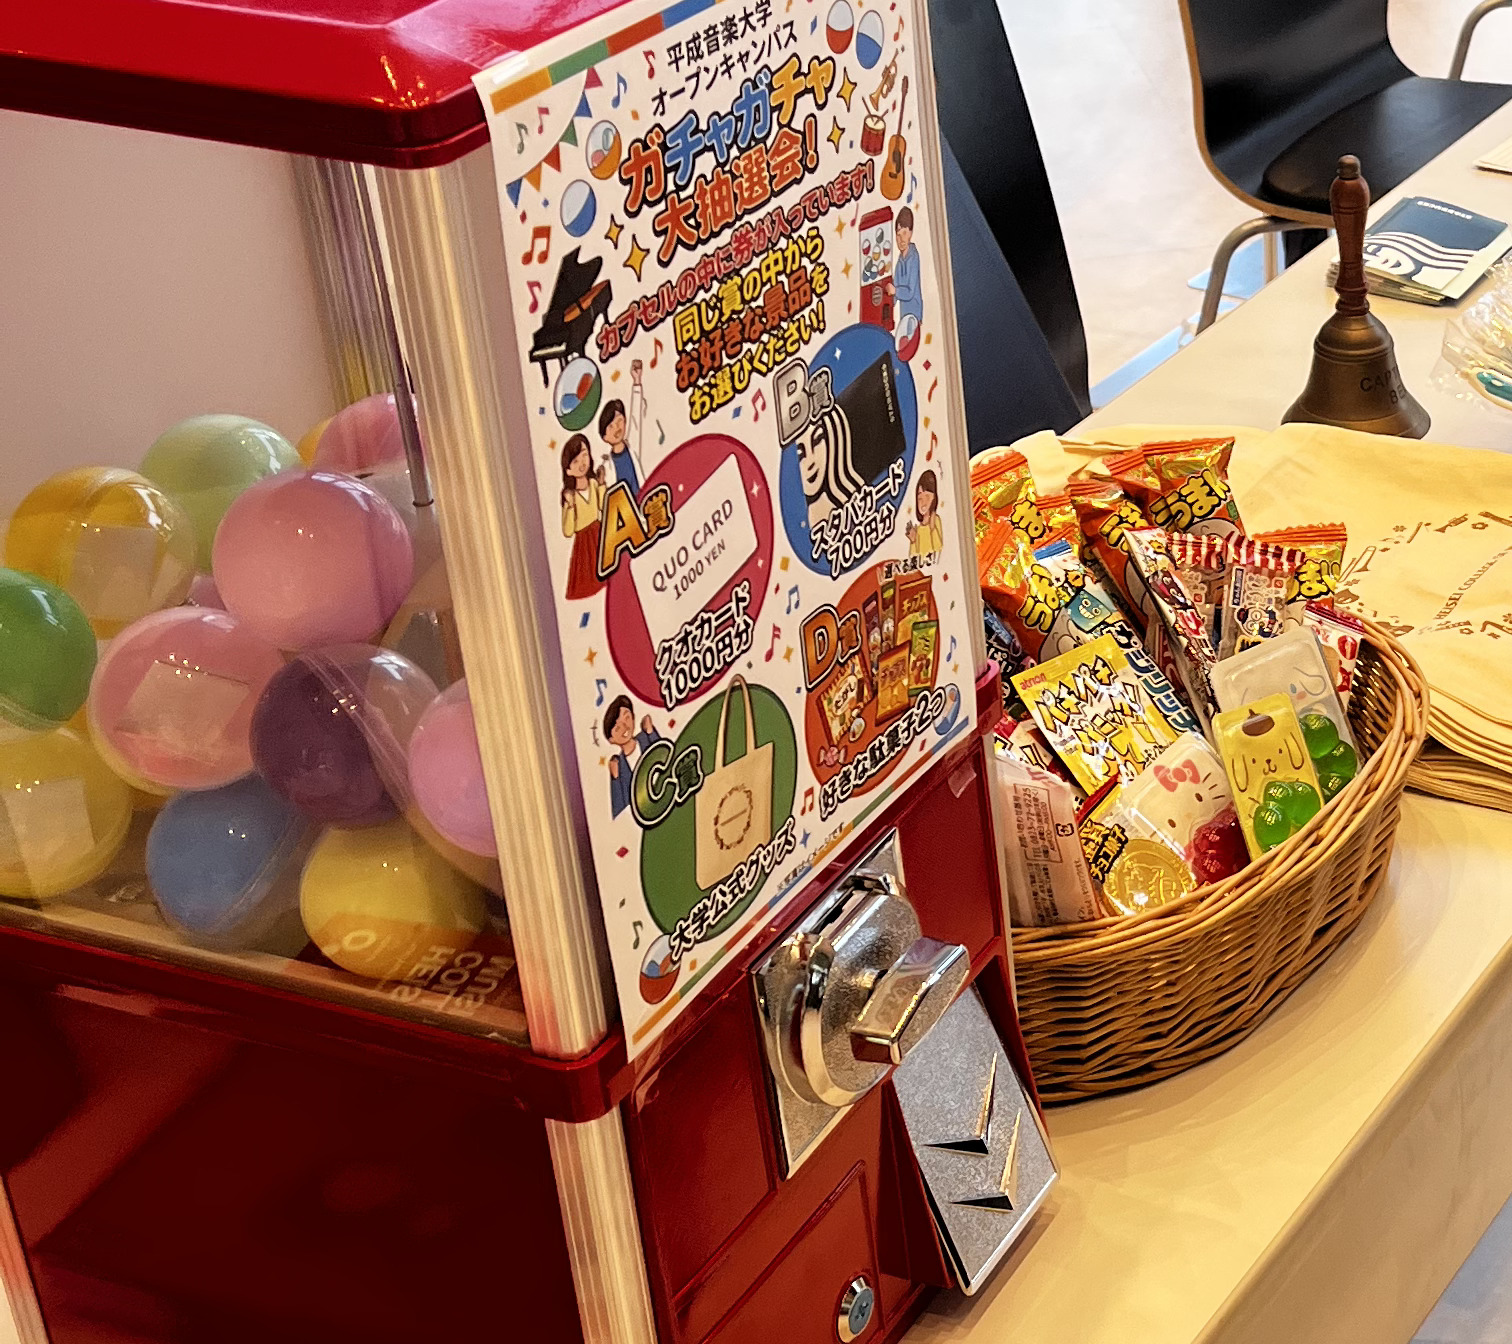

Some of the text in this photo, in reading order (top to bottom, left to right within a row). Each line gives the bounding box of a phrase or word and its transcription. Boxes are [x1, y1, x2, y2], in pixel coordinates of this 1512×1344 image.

[652, 20, 798, 116] オープンキャンパス
[620, 55, 835, 215] ガチャガチャ
[655, 115, 818, 264] 大抽選会!
[597, 158, 875, 362] カプセルの中に券が入っています!
[673, 227, 825, 352] 同じ賞の中から
[675, 263, 829, 393] お好きな景品を
[689, 300, 826, 423] お選びください!
[652, 499, 733, 592] QUO CARD
[673, 539, 726, 600] 1000 YEN
[810, 457, 906, 560] スタバカード
[827, 503, 895, 579] 700円分
[657, 581, 751, 680] クオカード
[661, 616, 755, 711] 1000円分
[819, 687, 946, 821] 好きな駄菓子2つ
[670, 816, 796, 961] 大学公式グッズ
